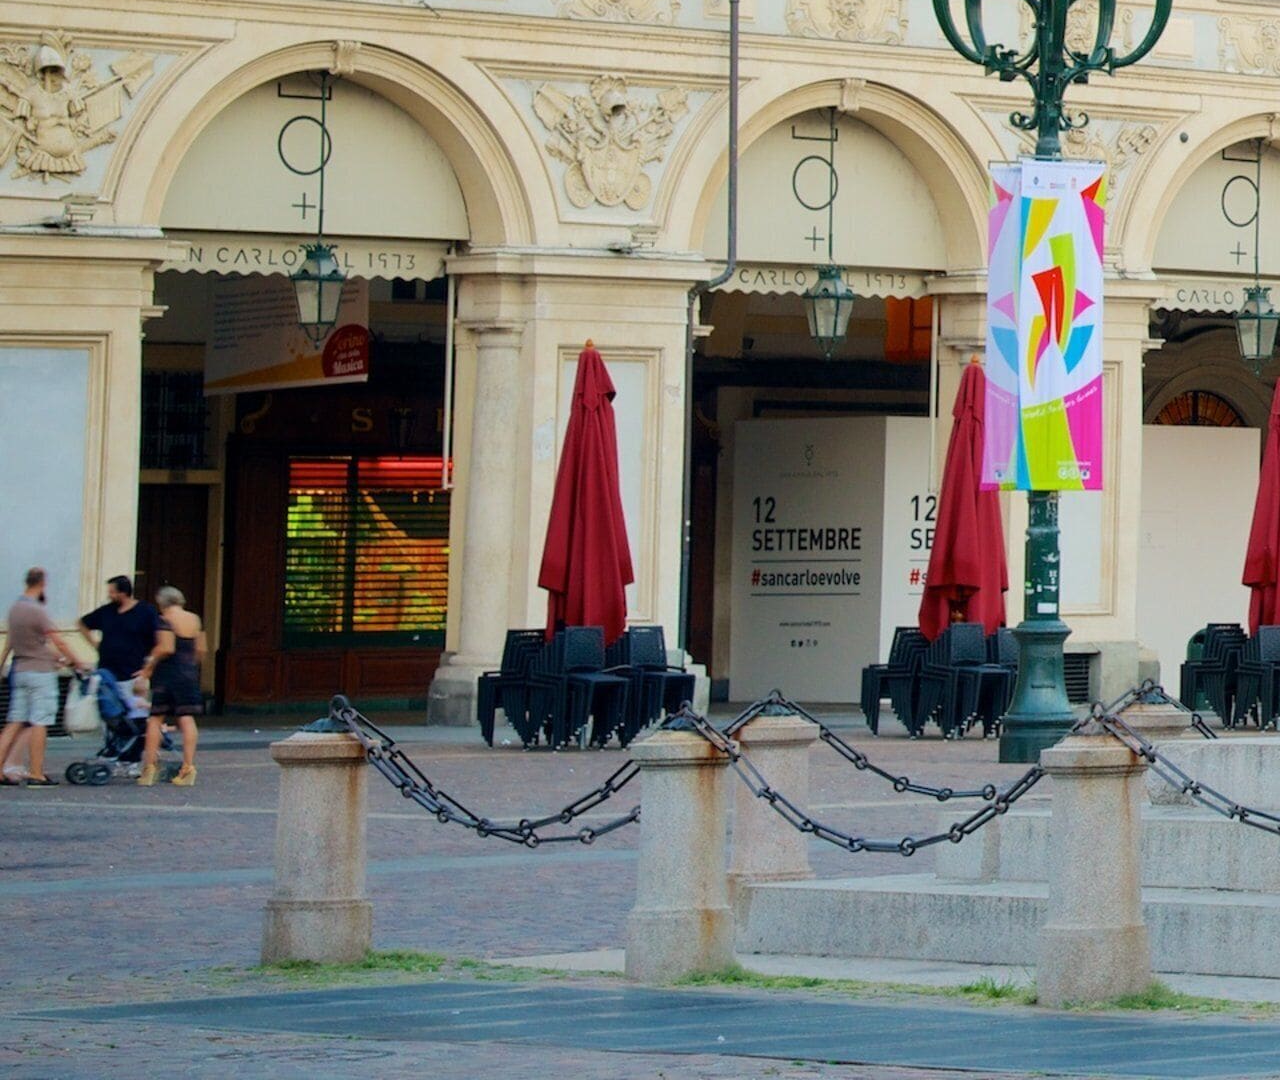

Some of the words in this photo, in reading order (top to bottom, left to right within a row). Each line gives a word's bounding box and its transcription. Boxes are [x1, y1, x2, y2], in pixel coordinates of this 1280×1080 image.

[217, 247, 297, 266] CARLO
[368, 252, 416, 271] 1973
[739, 269, 807, 286] CARLO
[866, 273, 906, 290] 1973
[1176, 289, 1234, 306] CARLO
[752, 496, 776, 523] 12
[911, 495, 937, 521] 12
[752, 528, 861, 551] SETTEMBRE
[752, 568, 860, 587] #sancarloevolve
